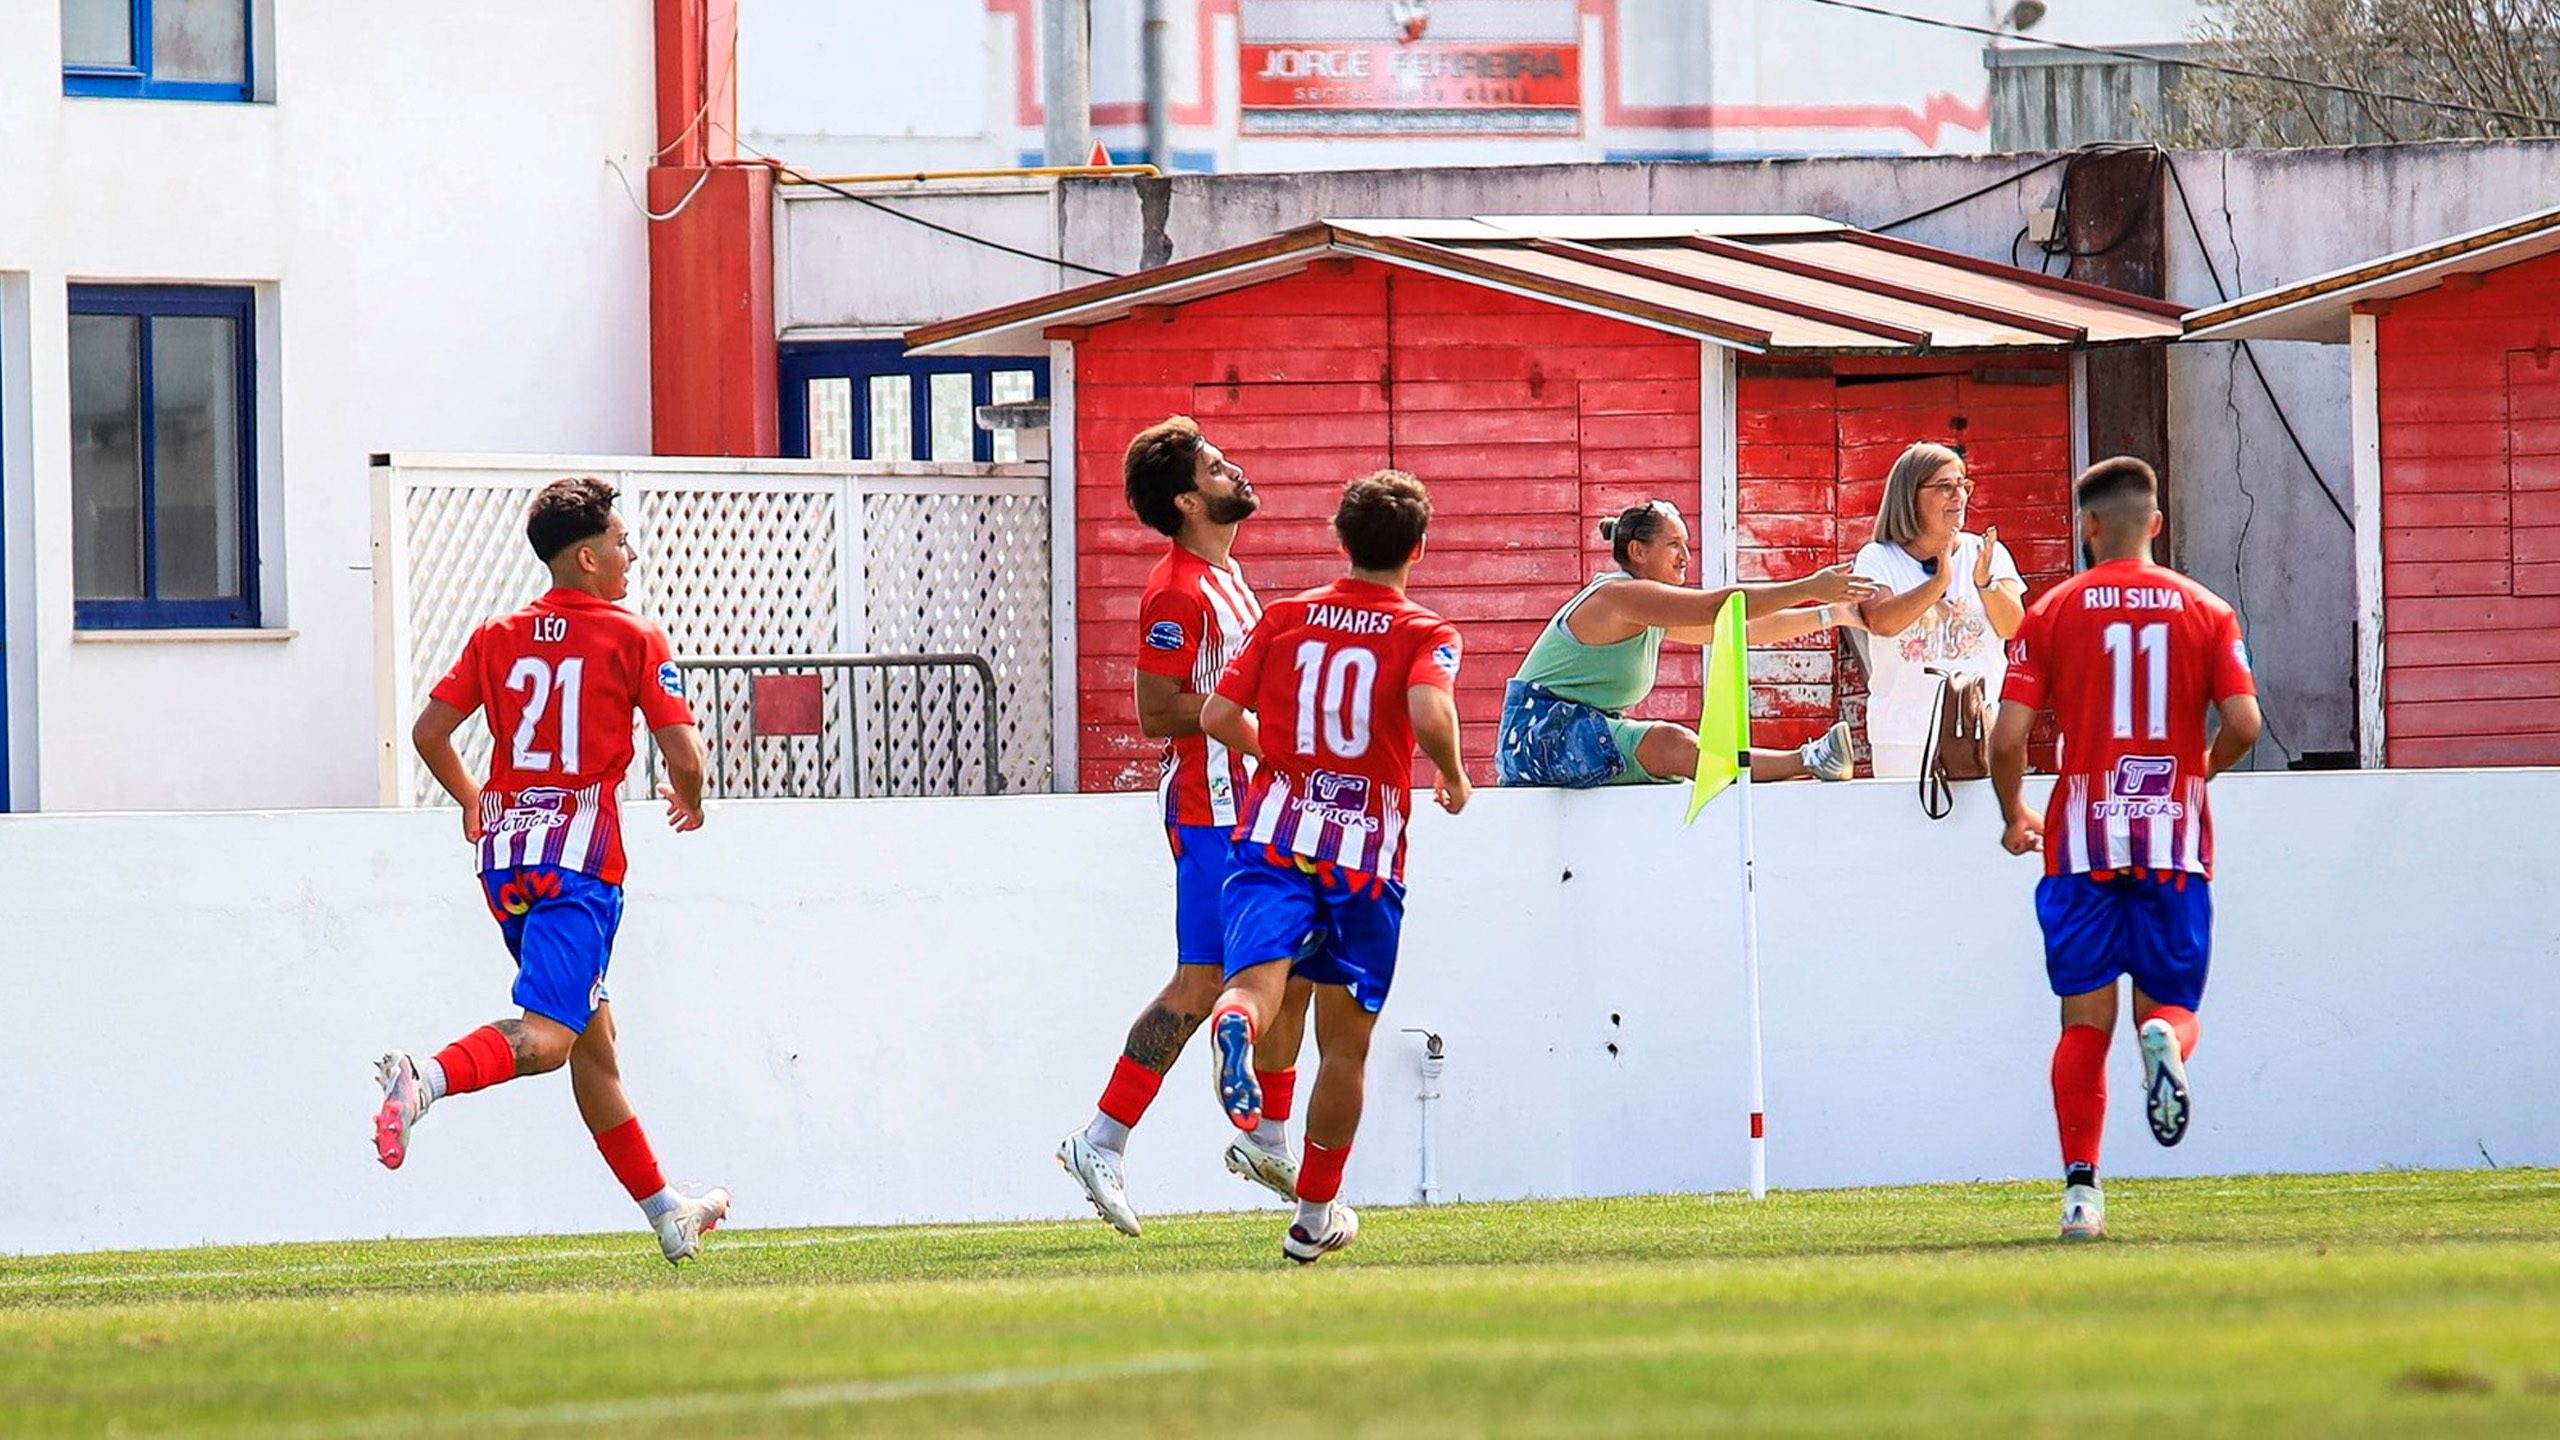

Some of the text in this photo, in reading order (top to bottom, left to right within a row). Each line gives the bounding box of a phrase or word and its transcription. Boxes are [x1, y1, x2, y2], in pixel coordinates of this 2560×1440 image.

[1258, 50, 1563, 78] JORGE FERREIRA
[2084, 586, 2185, 612] RUI SILVA
[533, 612, 567, 642] LÉO
[1305, 603, 1393, 634] TAVARES
[2104, 621, 2169, 740] 11
[1294, 638, 1377, 759] 10
[505, 656, 584, 775] 21
[2093, 801, 2183, 819] TUTIGAS
